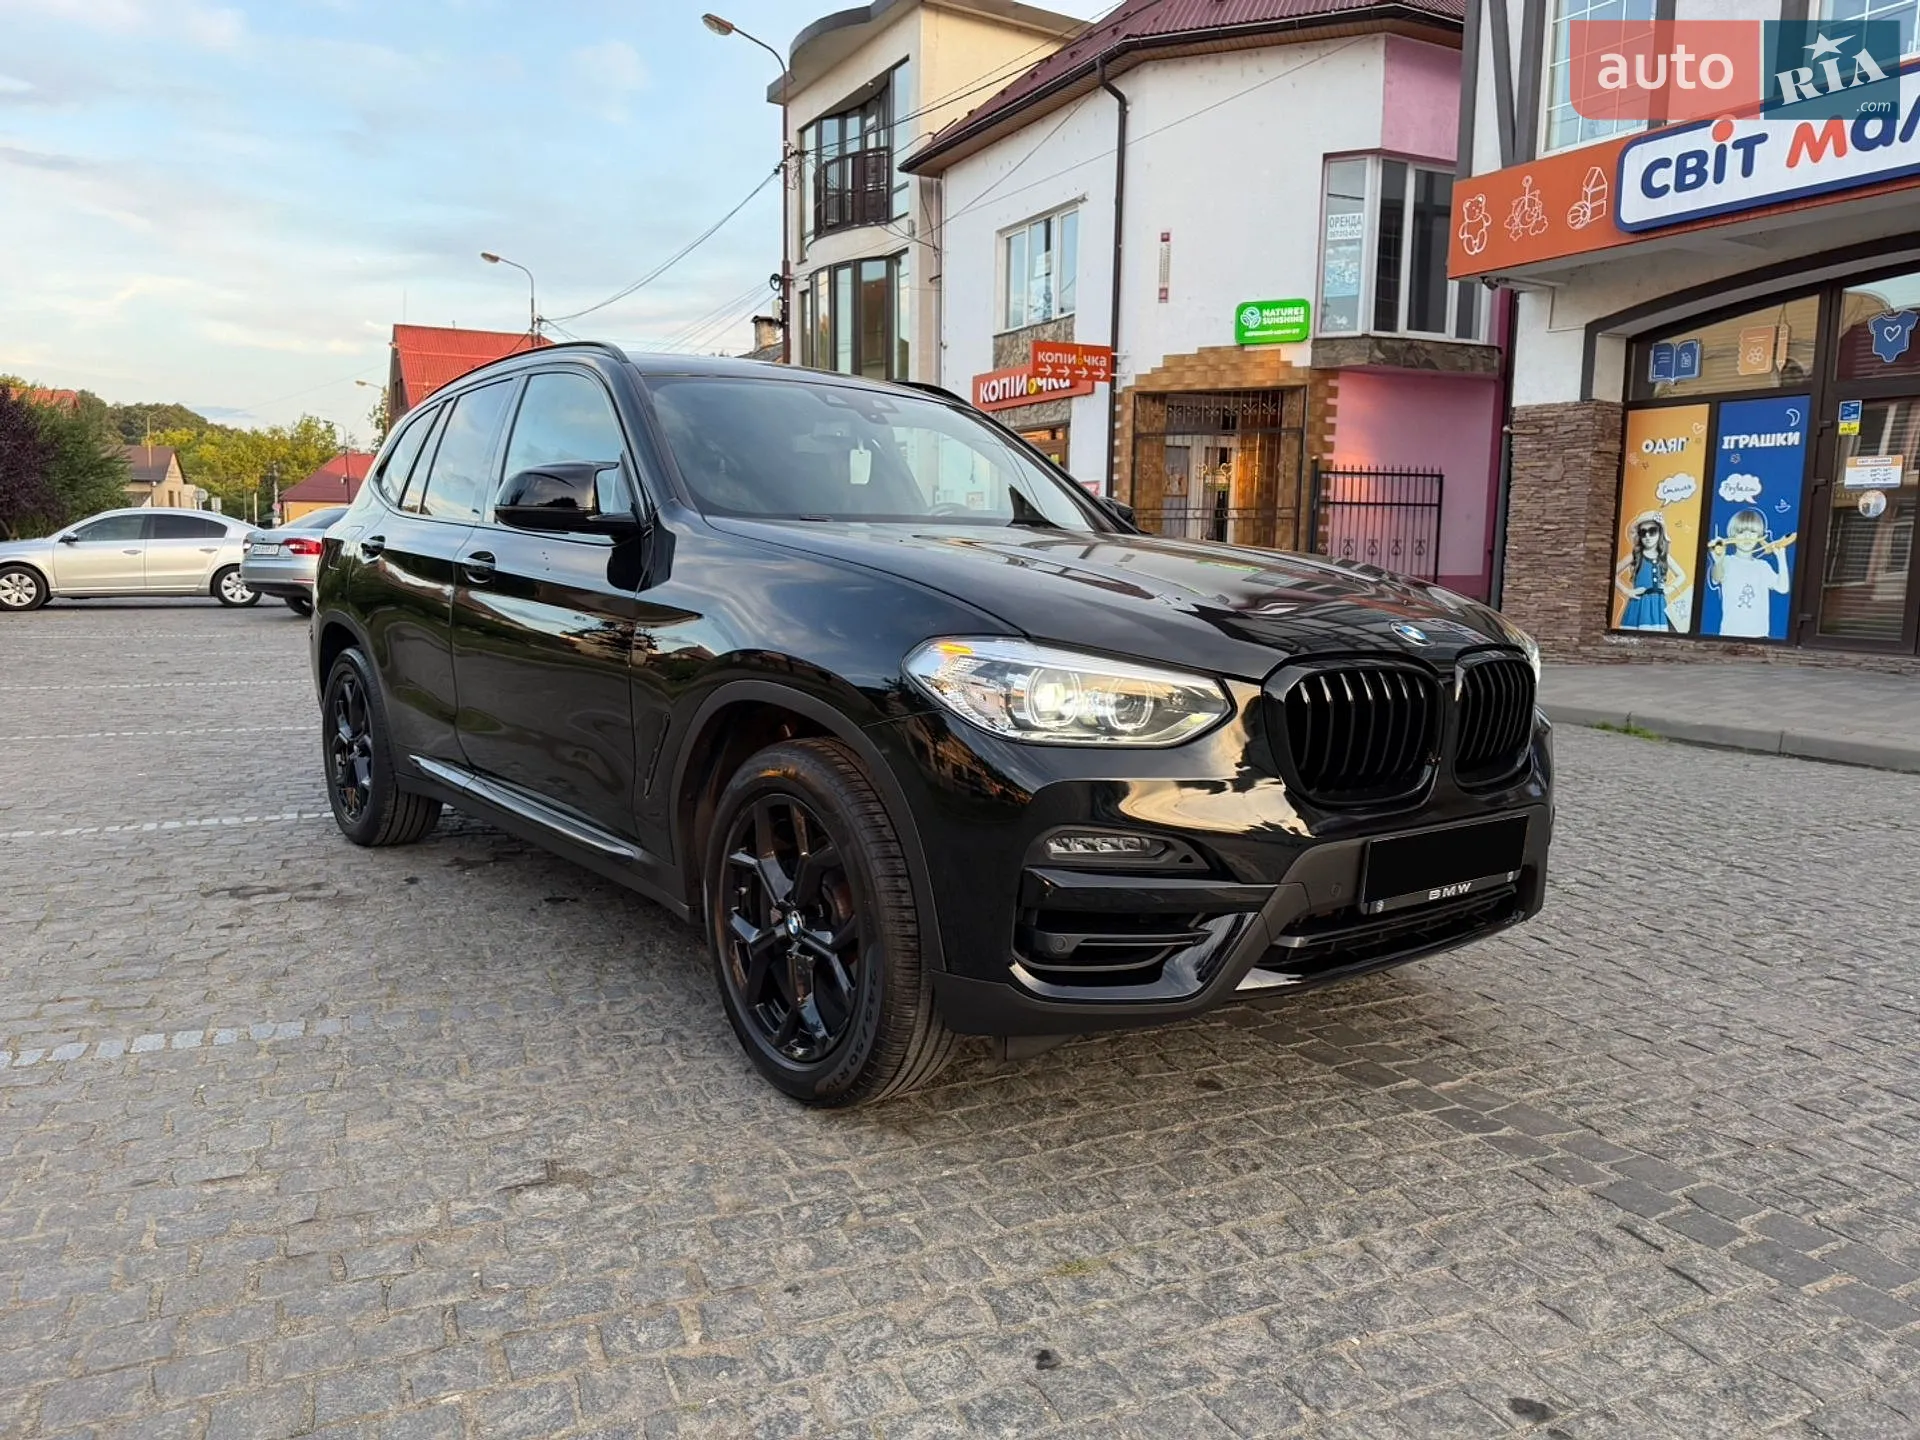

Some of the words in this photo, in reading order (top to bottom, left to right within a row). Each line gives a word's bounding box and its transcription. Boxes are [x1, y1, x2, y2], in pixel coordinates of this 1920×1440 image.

[1328, 214, 1362, 229] ОРЕНДА
[1721, 431, 1801, 450] ІГРАШКИ
[1428, 882, 1472, 901] BMW
